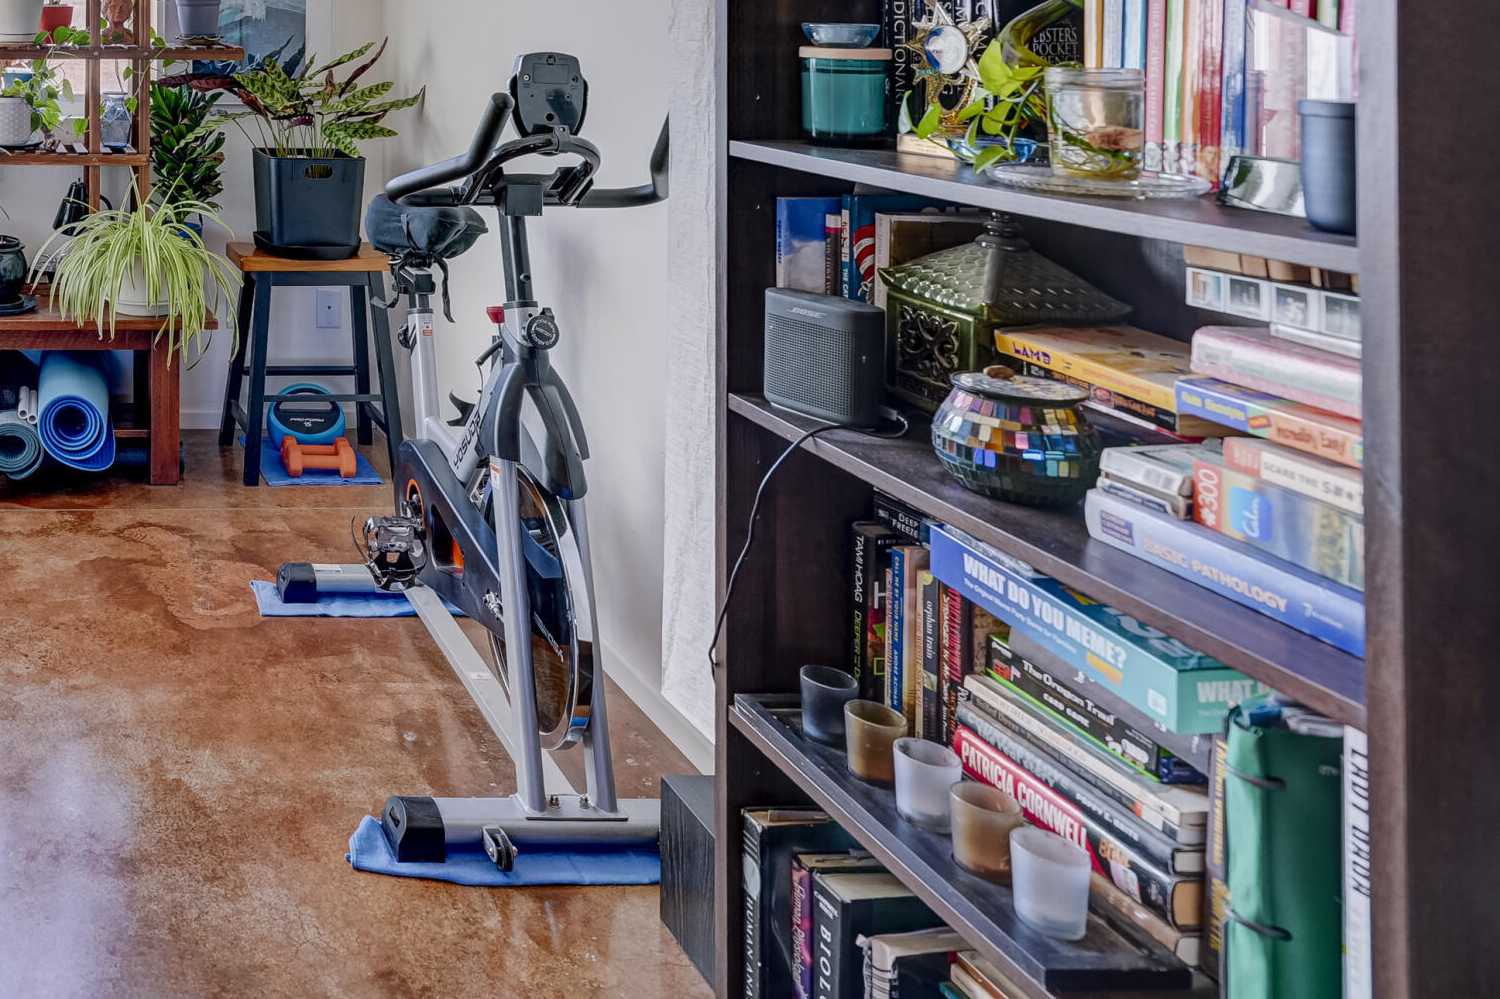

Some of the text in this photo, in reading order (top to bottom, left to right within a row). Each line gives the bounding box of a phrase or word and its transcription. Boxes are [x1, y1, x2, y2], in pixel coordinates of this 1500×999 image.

[1033, 42, 1078, 56] POCKET
[787, 306, 828, 319] BOSE
[1012, 342, 1052, 366] LAMB
[891, 517, 919, 539] FREEZE
[898, 512, 919, 528] DEEP
[1242, 496, 1262, 538] Calm
[853, 535, 865, 654] TAMI HOAG DEEPER
[1143, 539, 1189, 569] BASIC
[1190, 559, 1289, 613] PATHOLOGY
[924, 600, 936, 659] orphan train
[963, 552, 1127, 669] WHAT DO YOU MEME?
[1021, 659, 1116, 725] The Oregon Trail
[1197, 679, 1253, 703] WHAT
[961, 740, 1087, 851] PATRICIA CORNWELL
[744, 896, 759, 957] HUMAN
